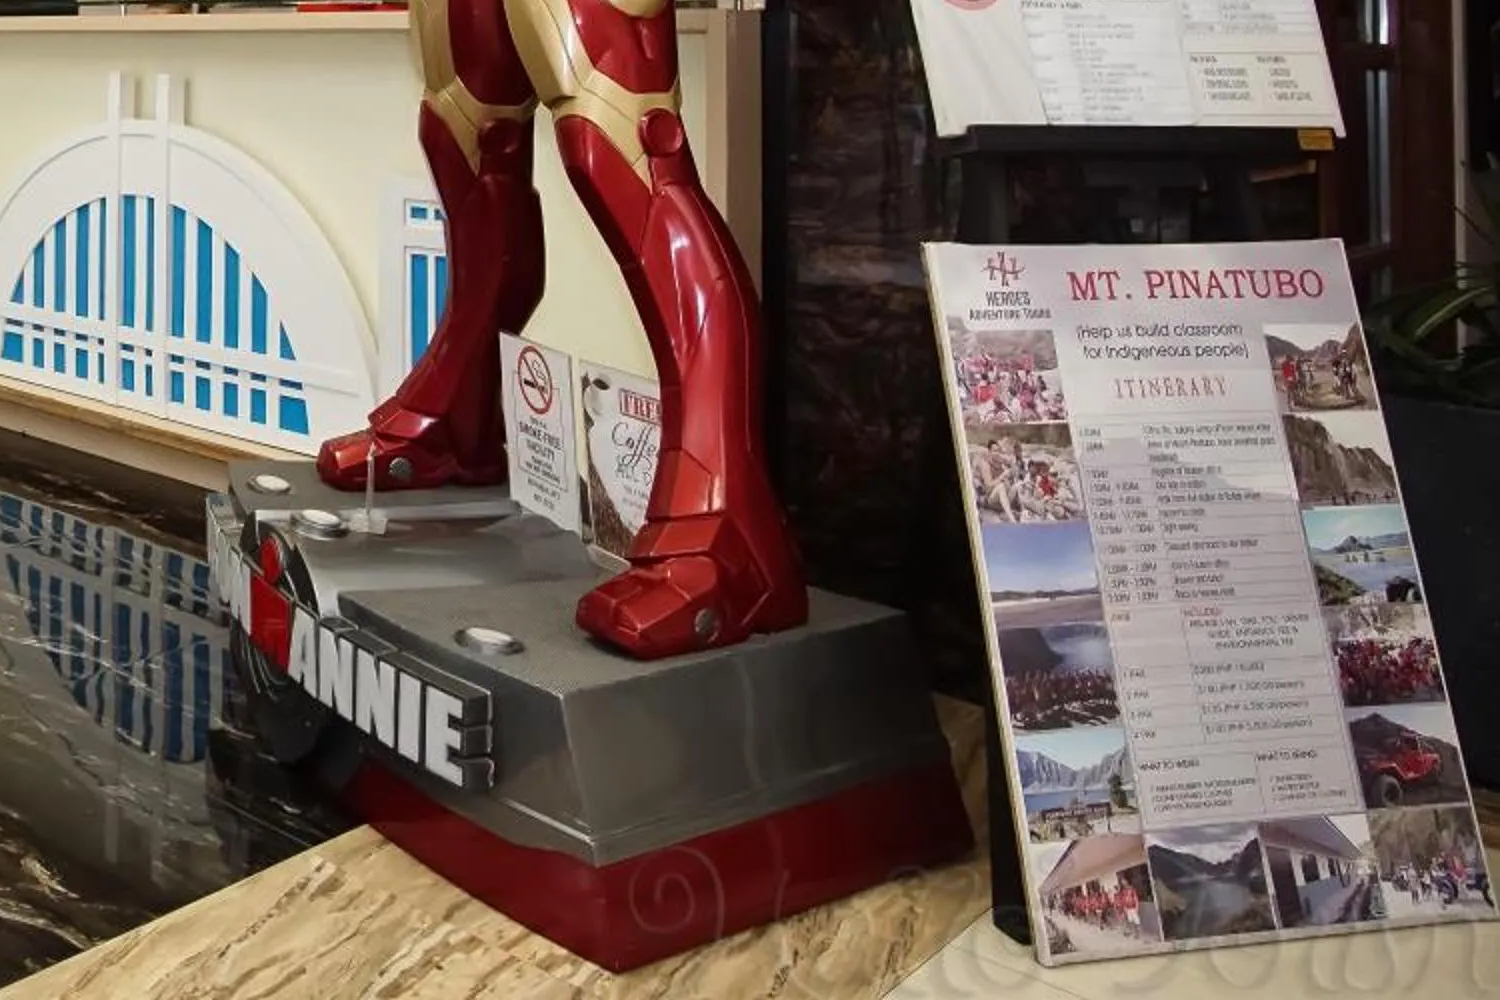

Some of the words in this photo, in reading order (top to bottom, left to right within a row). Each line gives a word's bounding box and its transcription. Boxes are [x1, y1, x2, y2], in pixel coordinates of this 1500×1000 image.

[1066, 271, 1132, 300] MT.
[1144, 269, 1324, 300] PINATUBO
[1113, 376, 1228, 400] ITINERARY
[287, 605, 464, 788] ANNIE
